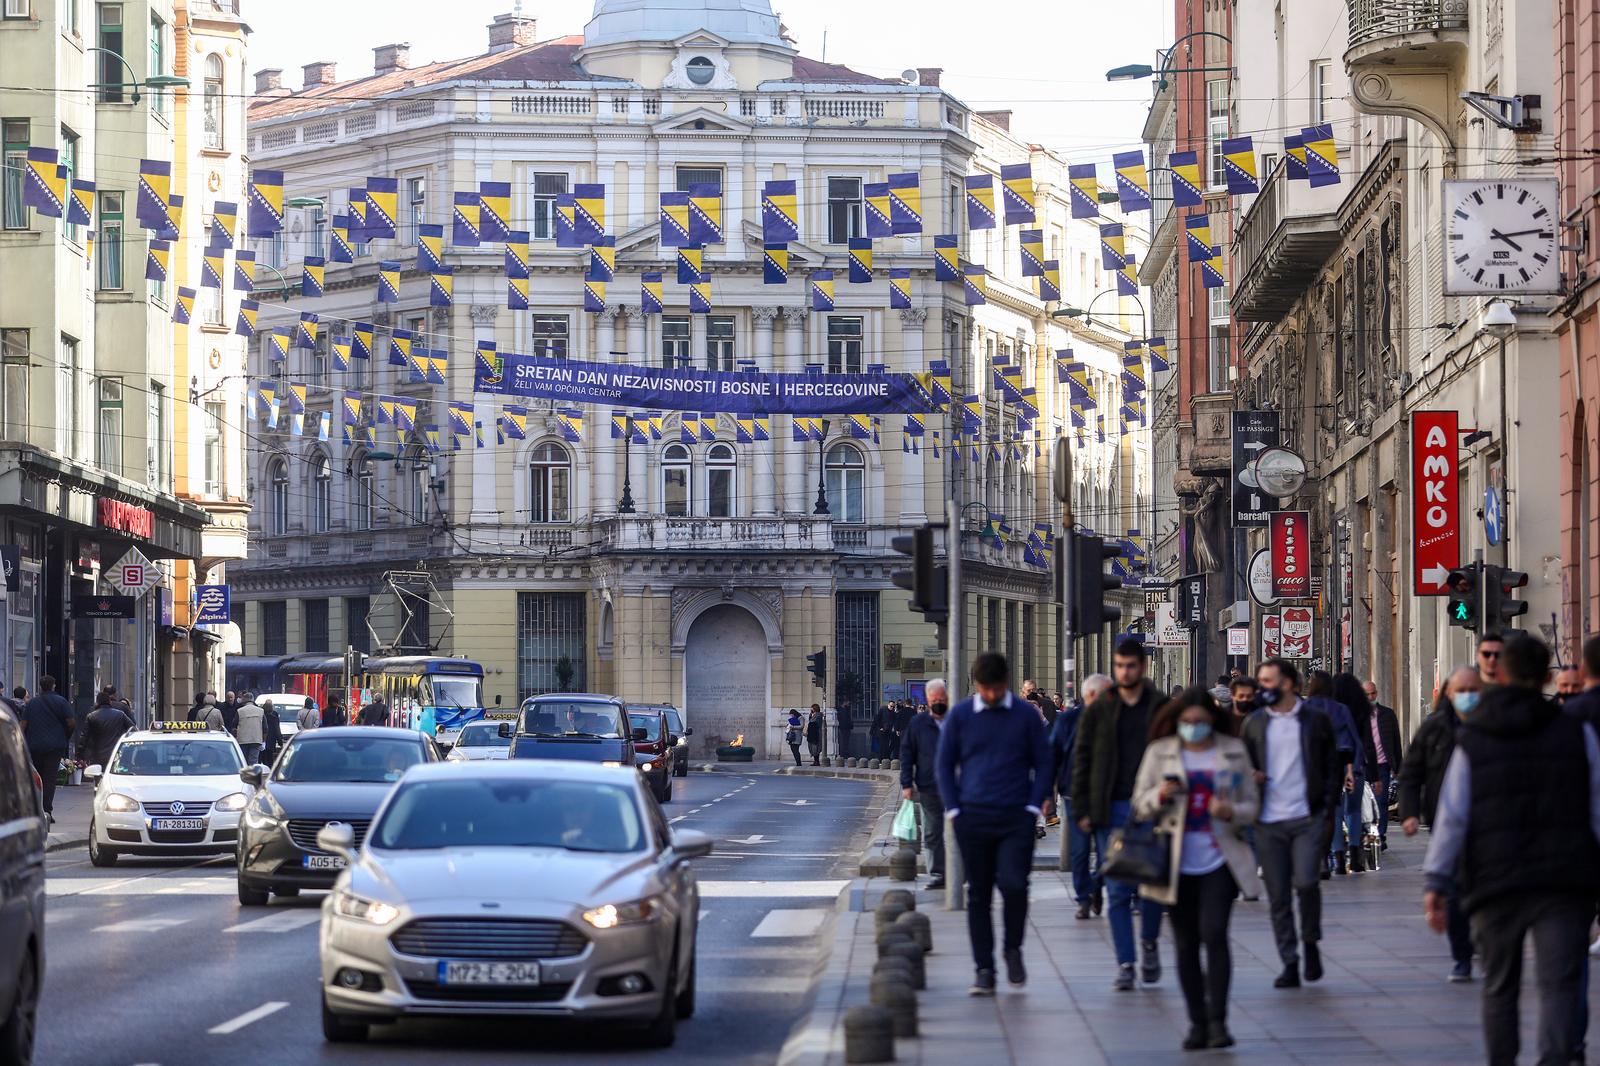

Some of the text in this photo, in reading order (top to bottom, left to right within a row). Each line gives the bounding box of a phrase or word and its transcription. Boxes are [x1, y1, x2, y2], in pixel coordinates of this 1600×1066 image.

[515, 364, 889, 396] SRETAN DAN NEZAVISNOSTI BOSNE I HERCEGOVINE
[514, 378, 622, 398] ŽELI VAM OPĆINA CENTAR
[1423, 425, 1449, 528] AMKO
[1238, 511, 1270, 521] barcaff
[1284, 517, 1297, 573] BISTRO
[1145, 592, 1168, 602] FINE
[163, 721, 206, 730] TAXI 078
[158, 820, 202, 829] TA-281310
